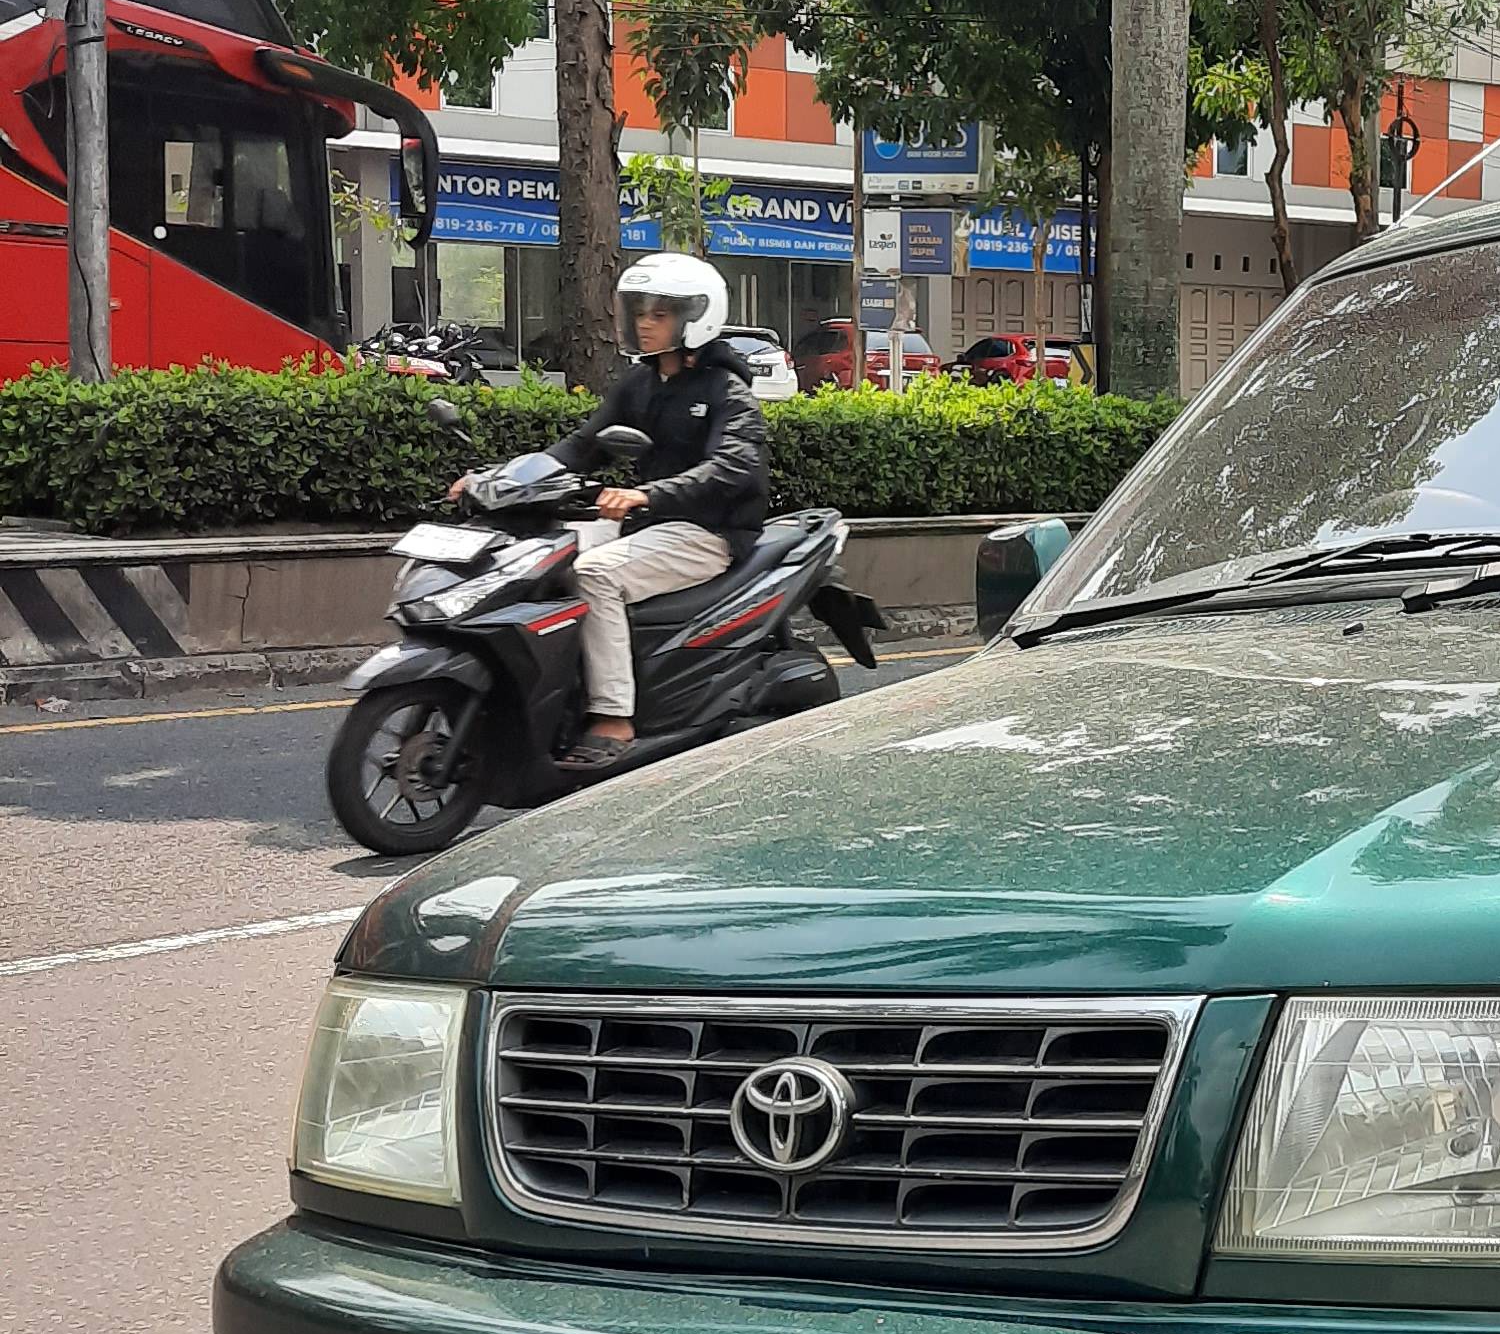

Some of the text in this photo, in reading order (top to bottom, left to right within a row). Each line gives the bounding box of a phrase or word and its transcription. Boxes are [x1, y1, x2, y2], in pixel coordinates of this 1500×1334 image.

[437, 175, 501, 197] NTOR
[727, 195, 821, 221] GRAND
[435, 218, 526, 235] 819-236-778
[794, 240, 816, 250] DAN
[818, 241, 854, 252] PERKA
[975, 239, 1053, 255] 0819-236-8
